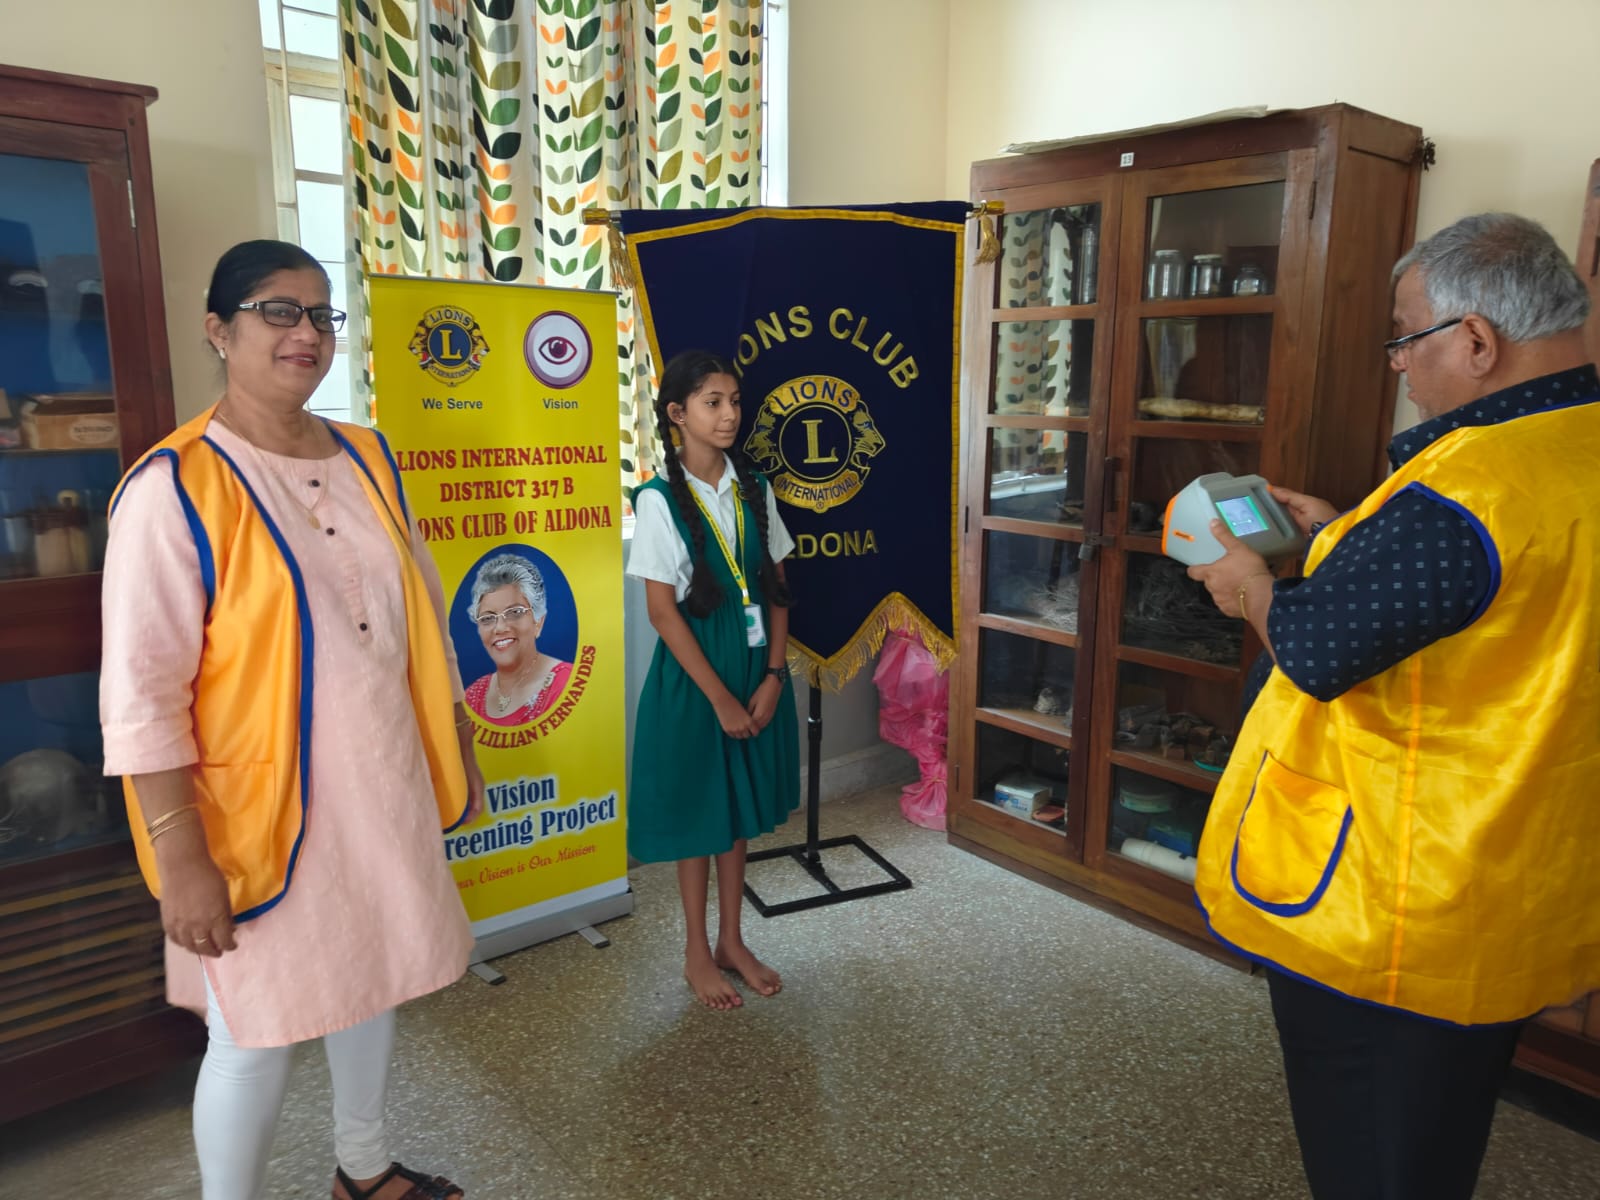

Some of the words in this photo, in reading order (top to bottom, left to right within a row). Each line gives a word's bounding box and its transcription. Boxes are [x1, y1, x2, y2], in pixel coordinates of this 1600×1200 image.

[430, 309, 472, 327] LIONS
[440, 329, 462, 360] L
[828, 307, 920, 389] CLUB
[421, 398, 443, 410] We
[446, 398, 483, 410] Serve
[542, 397, 579, 410] Vision
[773, 380, 853, 412] LIONS
[801, 419, 839, 464] L
[396, 449, 457, 471] LIONS
[462, 445, 608, 468] INTERNATIONAL
[440, 479, 527, 502] DISTRICT
[531, 479, 559, 499] 317
[563, 476, 574, 495] B
[780, 476, 857, 501] INTERNATIONAL
[418, 516, 456, 542] ONS
[462, 512, 507, 539] CLUB
[513, 511, 537, 534] OF
[544, 505, 612, 532] ALDONA
[786, 529, 879, 559] DONA
[478, 726, 539, 749] LILLIAN
[537, 645, 597, 737] FERNANDES
[487, 777, 555, 813] Vision
[444, 814, 534, 861] reening
[540, 793, 616, 837] Project
[479, 867, 514, 884] Vision
[517, 861, 526, 873] is
[529, 855, 553, 870] Our
[553, 844, 597, 863] Mission
